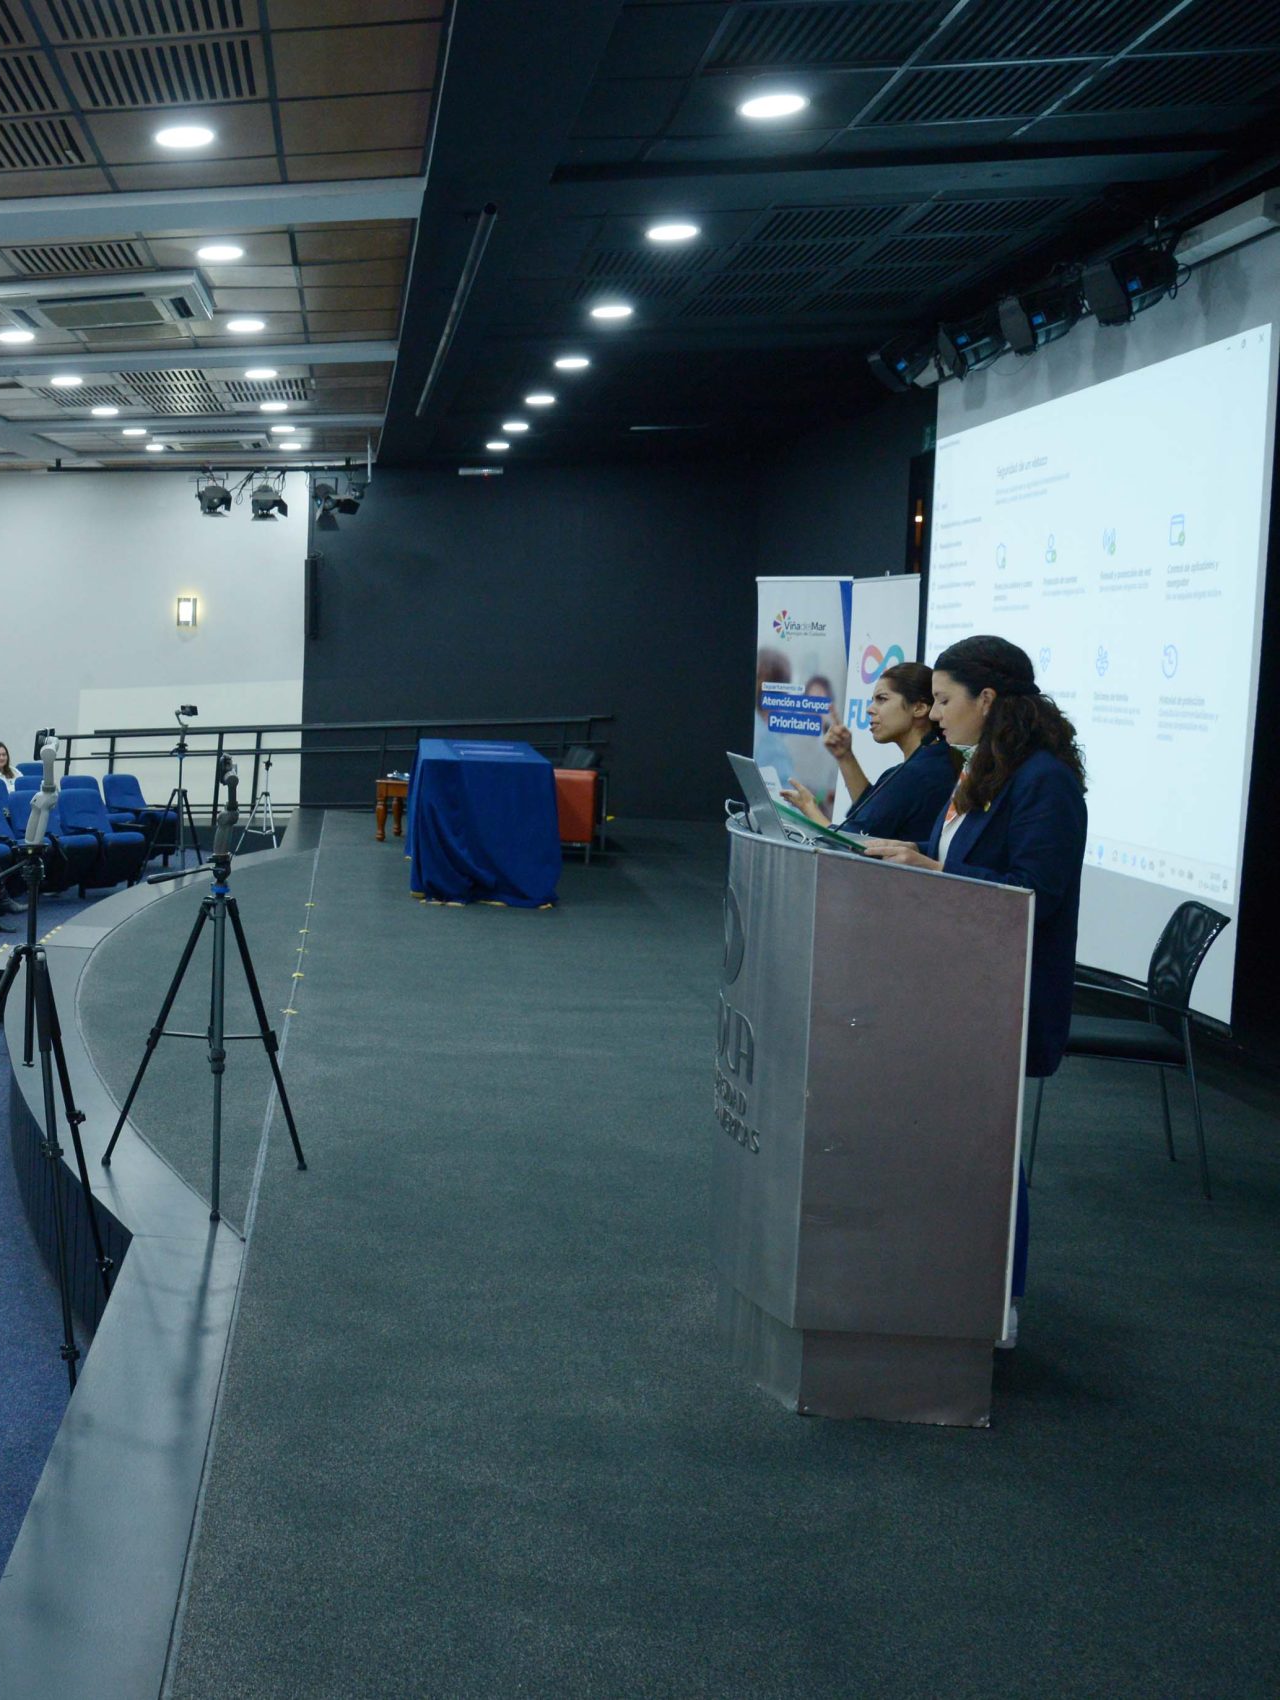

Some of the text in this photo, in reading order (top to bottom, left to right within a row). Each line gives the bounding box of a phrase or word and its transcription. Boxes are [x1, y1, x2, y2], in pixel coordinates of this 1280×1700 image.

[762, 695, 796, 708] Atención
[801, 699, 830, 713] Grupos
[769, 715, 821, 732] Prioritarios
